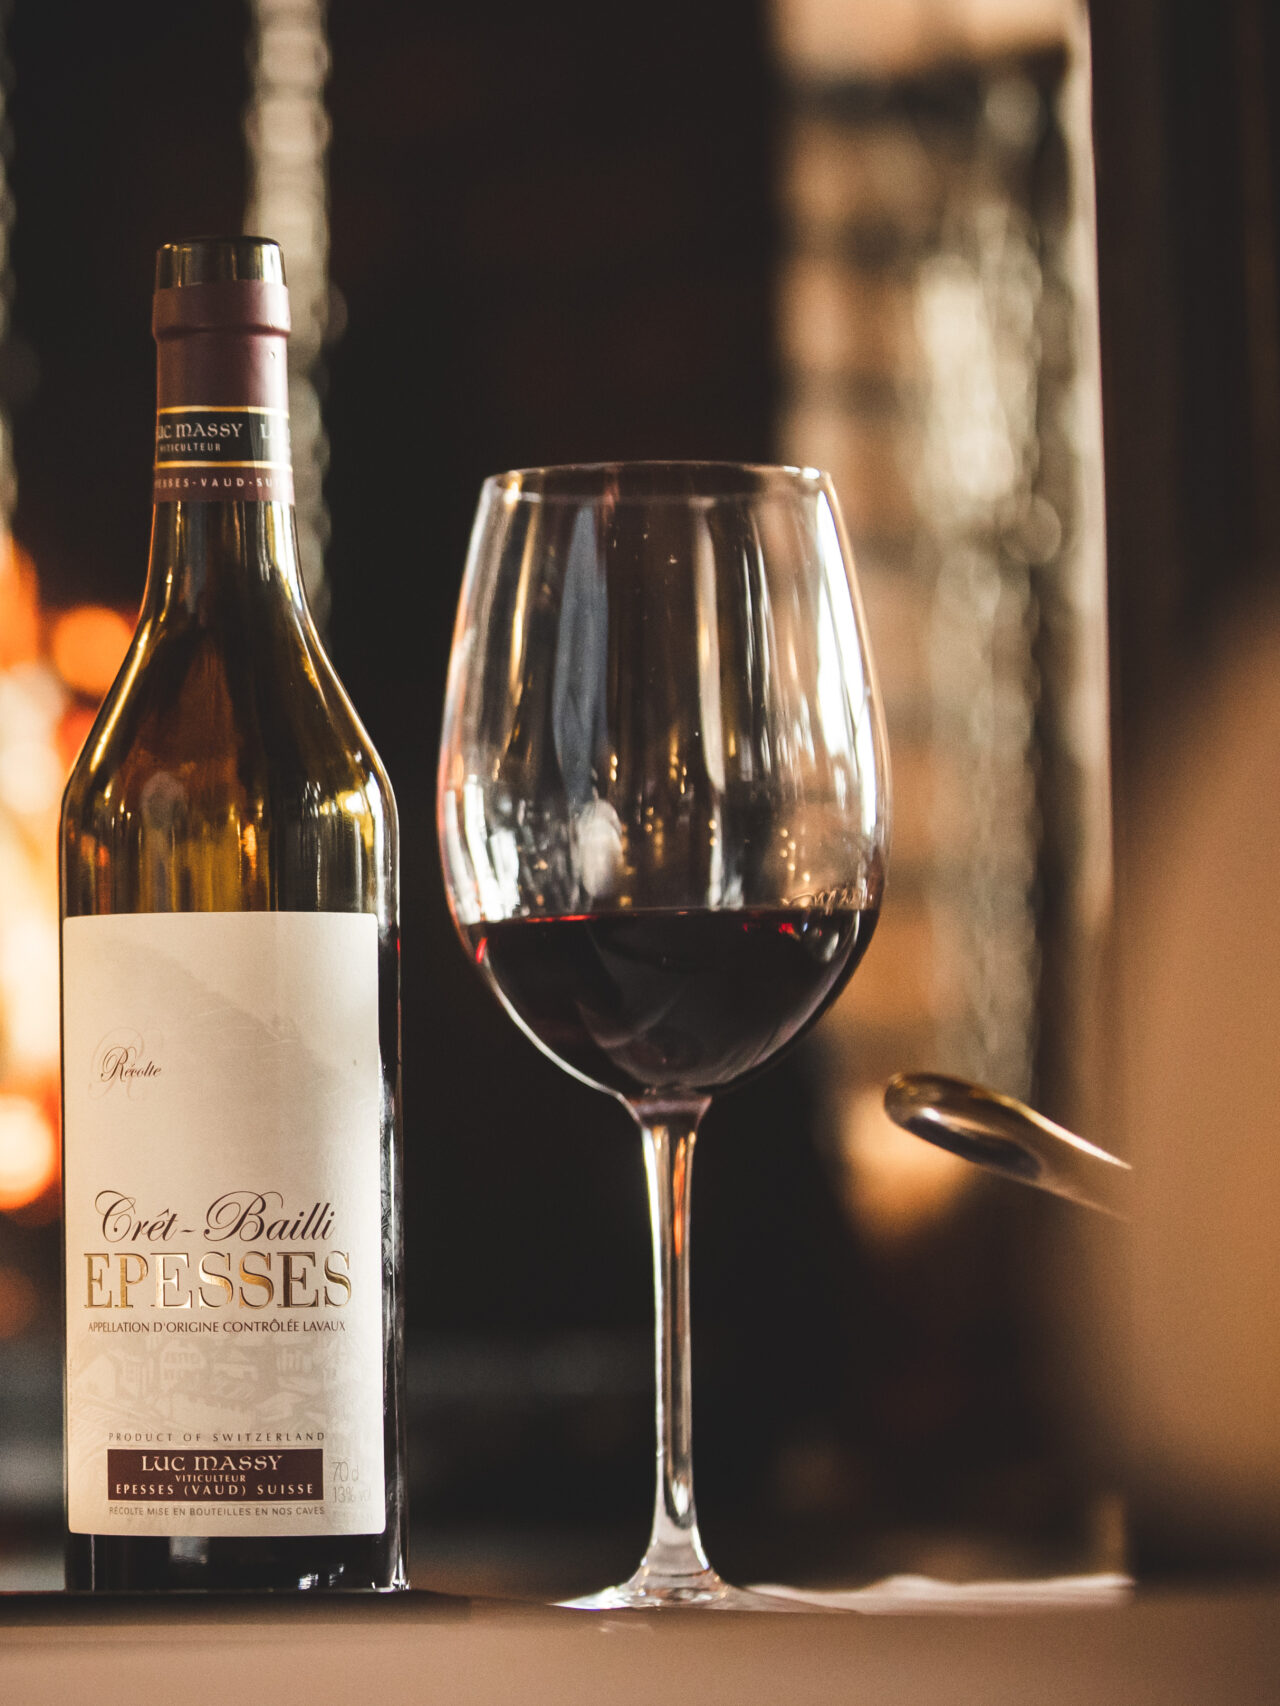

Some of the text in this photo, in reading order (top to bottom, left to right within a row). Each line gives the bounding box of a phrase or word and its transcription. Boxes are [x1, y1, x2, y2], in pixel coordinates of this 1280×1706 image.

[176, 423, 243, 437] MASSY
[101, 1046, 162, 1082] Récolte
[83, 1251, 352, 1309] EPESSES
[88, 1318, 346, 1332] APPELLATION D'ORIGINE CONTRÔLÉE LAVAUX
[108, 1432, 325, 1442] PRODUCT OF SWITZERLAND
[141, 1455, 282, 1471] LUC MASSY
[175, 1474, 246, 1483] VITICULTEUR
[116, 1484, 313, 1496] EPESSES (VAUD) SUISSE
[109, 1506, 144, 1516] RÉCOLTE
[147, 1508, 169, 1516] MISE
[173, 1508, 186, 1516] EN
[189, 1508, 251, 1517] BOUTEILLES
[255, 1508, 268, 1516] EN
[295, 1507, 325, 1515] CAVES
